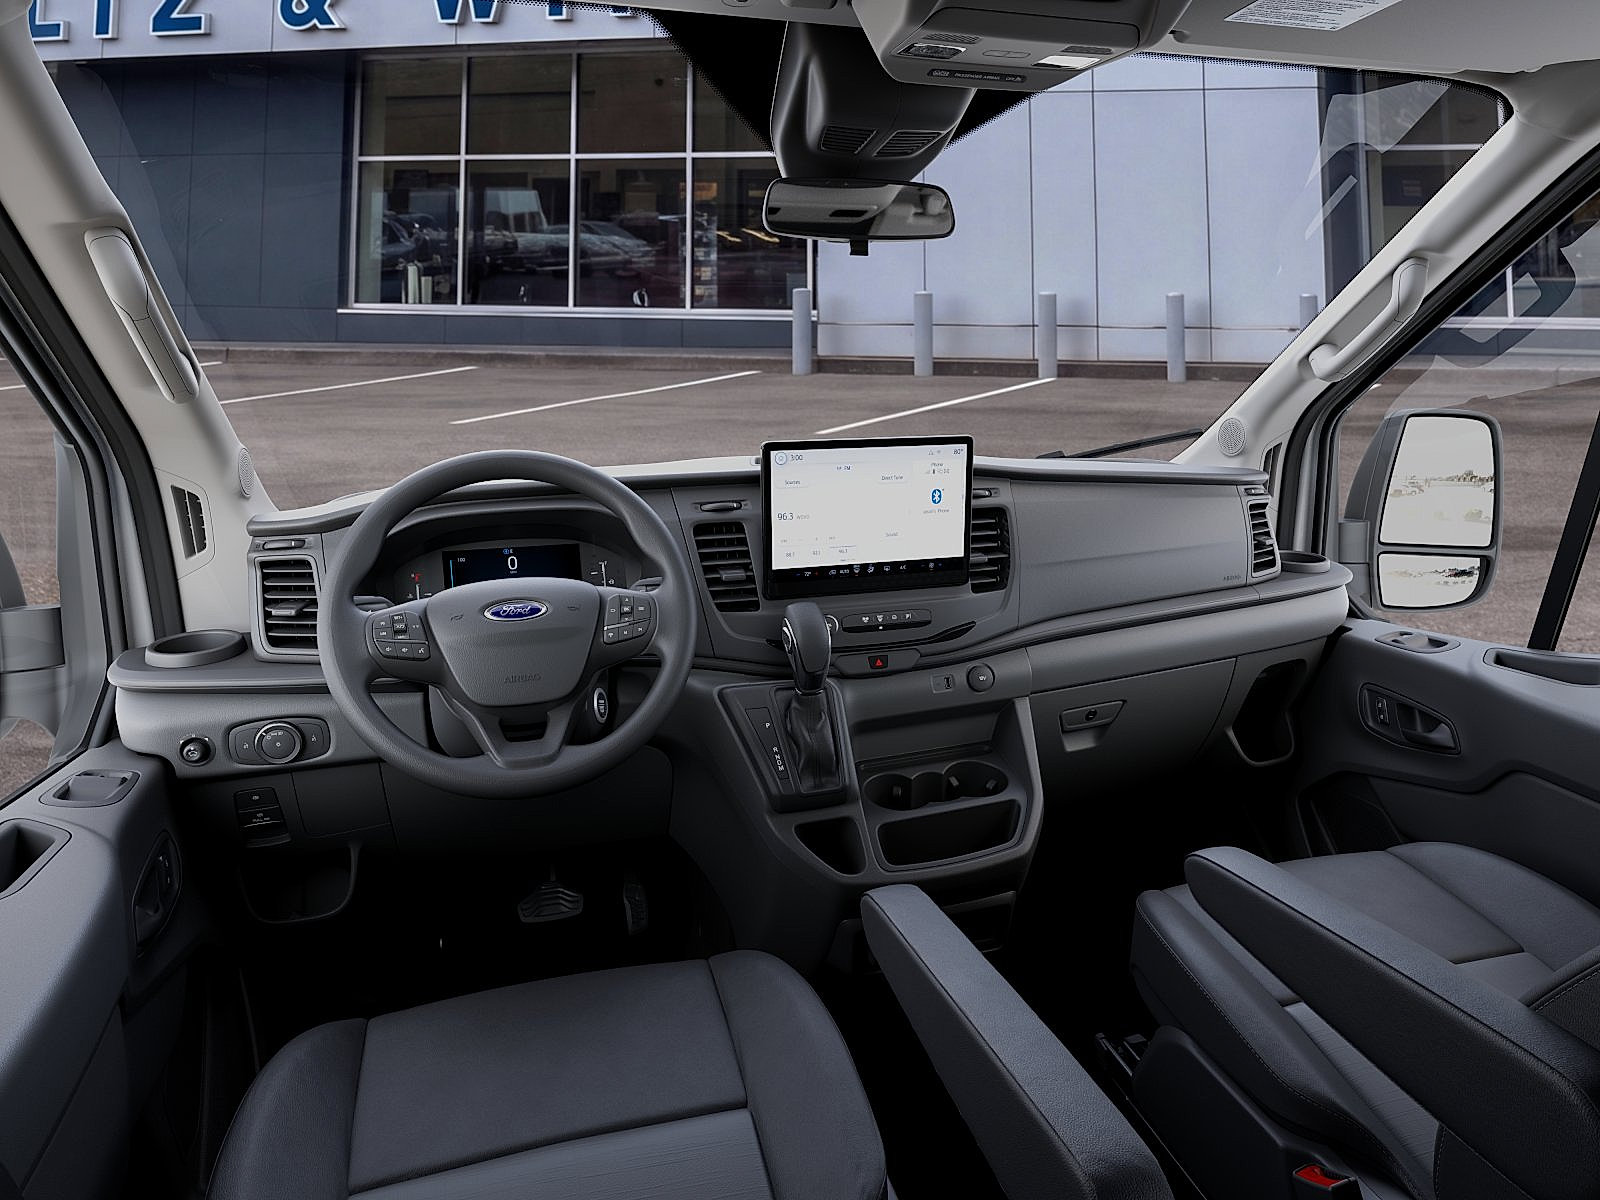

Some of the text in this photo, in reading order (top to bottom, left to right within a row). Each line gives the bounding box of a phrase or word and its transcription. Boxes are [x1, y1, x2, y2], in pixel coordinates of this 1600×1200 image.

[508, 556, 518, 570] 0
[500, 603, 532, 616] Ford
[504, 673, 542, 684] AIRBAG
